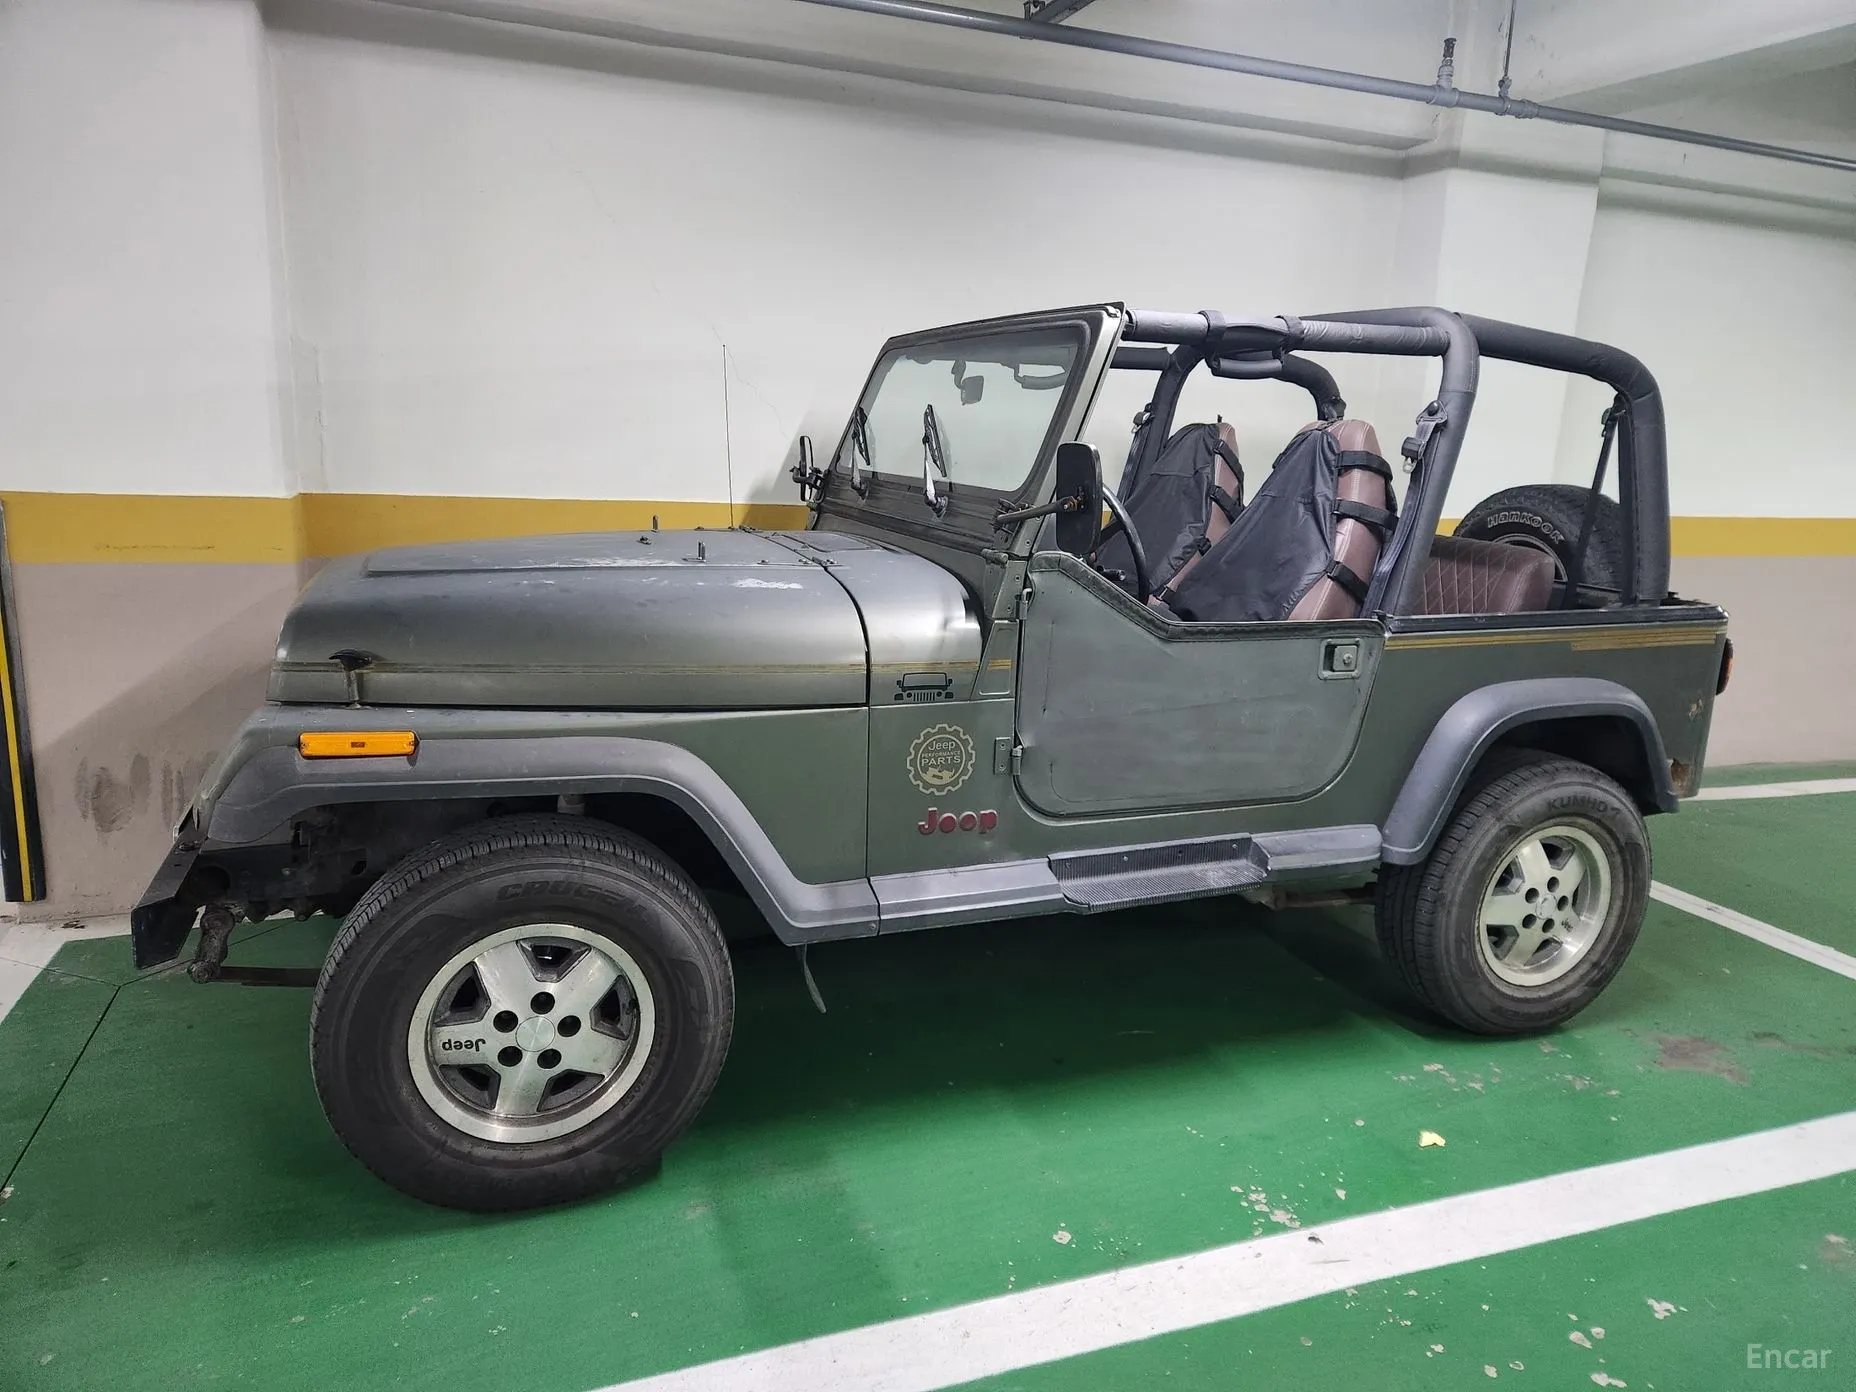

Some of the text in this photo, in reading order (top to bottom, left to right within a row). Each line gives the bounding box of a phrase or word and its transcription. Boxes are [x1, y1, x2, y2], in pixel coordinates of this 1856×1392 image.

[928, 740, 956, 751] Jeep
[921, 755, 961, 766] PARTS
[441, 1038, 486, 1052] Jeep
